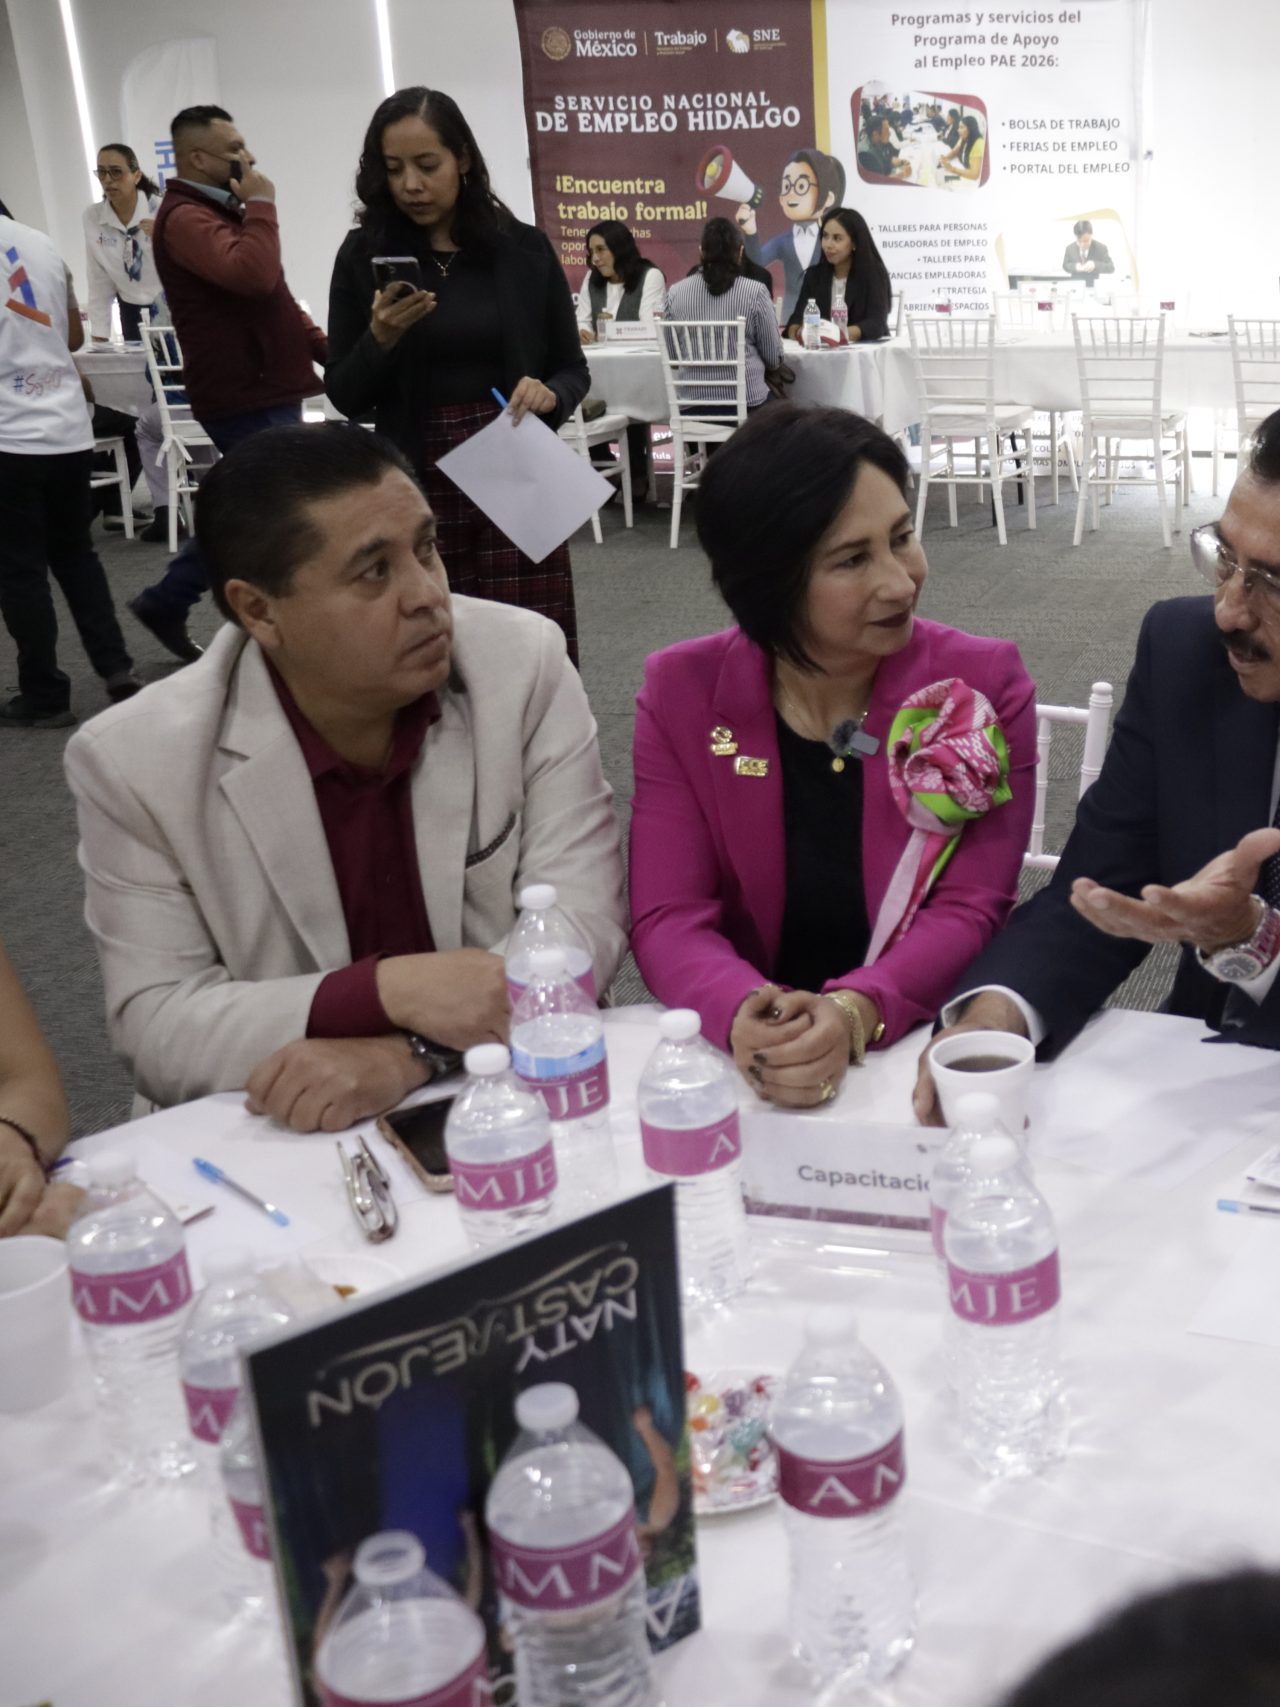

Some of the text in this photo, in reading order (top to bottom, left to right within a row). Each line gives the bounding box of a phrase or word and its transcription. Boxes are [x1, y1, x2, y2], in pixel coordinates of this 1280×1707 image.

[891, 10, 1081, 29] Programas y servicios del
[574, 29, 636, 40] Gobierno de
[654, 30, 708, 46] Trabajo
[753, 28, 780, 41] SNE
[913, 33, 1060, 51] Programa de Apoyo
[575, 39, 638, 57] México
[914, 54, 1060, 71] al Empleo PAE 2026:
[554, 91, 771, 111] SERVICIO NACIONAL
[536, 106, 801, 133] DE EMPLEO HIDALGO
[1008, 118, 1121, 131] BOLSA DE TRABAJO
[1009, 140, 1118, 152] FERIAS DE EMPLEO
[1010, 162, 1131, 175] PORTAL DEL EMPLEO
[556, 175, 665, 194] ¡Encuentra
[635, 201, 708, 220] formal!
[878, 223, 988, 232] TALLERES PARA PERSONAS
[882, 240, 939, 248] BUSCADORAS
[953, 239, 988, 247] EMPLEO
[923, 255, 986, 263] TALLERES PARA
[924, 271, 987, 279] EMPLEADORAS
[798, 1164, 930, 1192] Capacitaci
[517, 1289, 637, 1374] NATY
